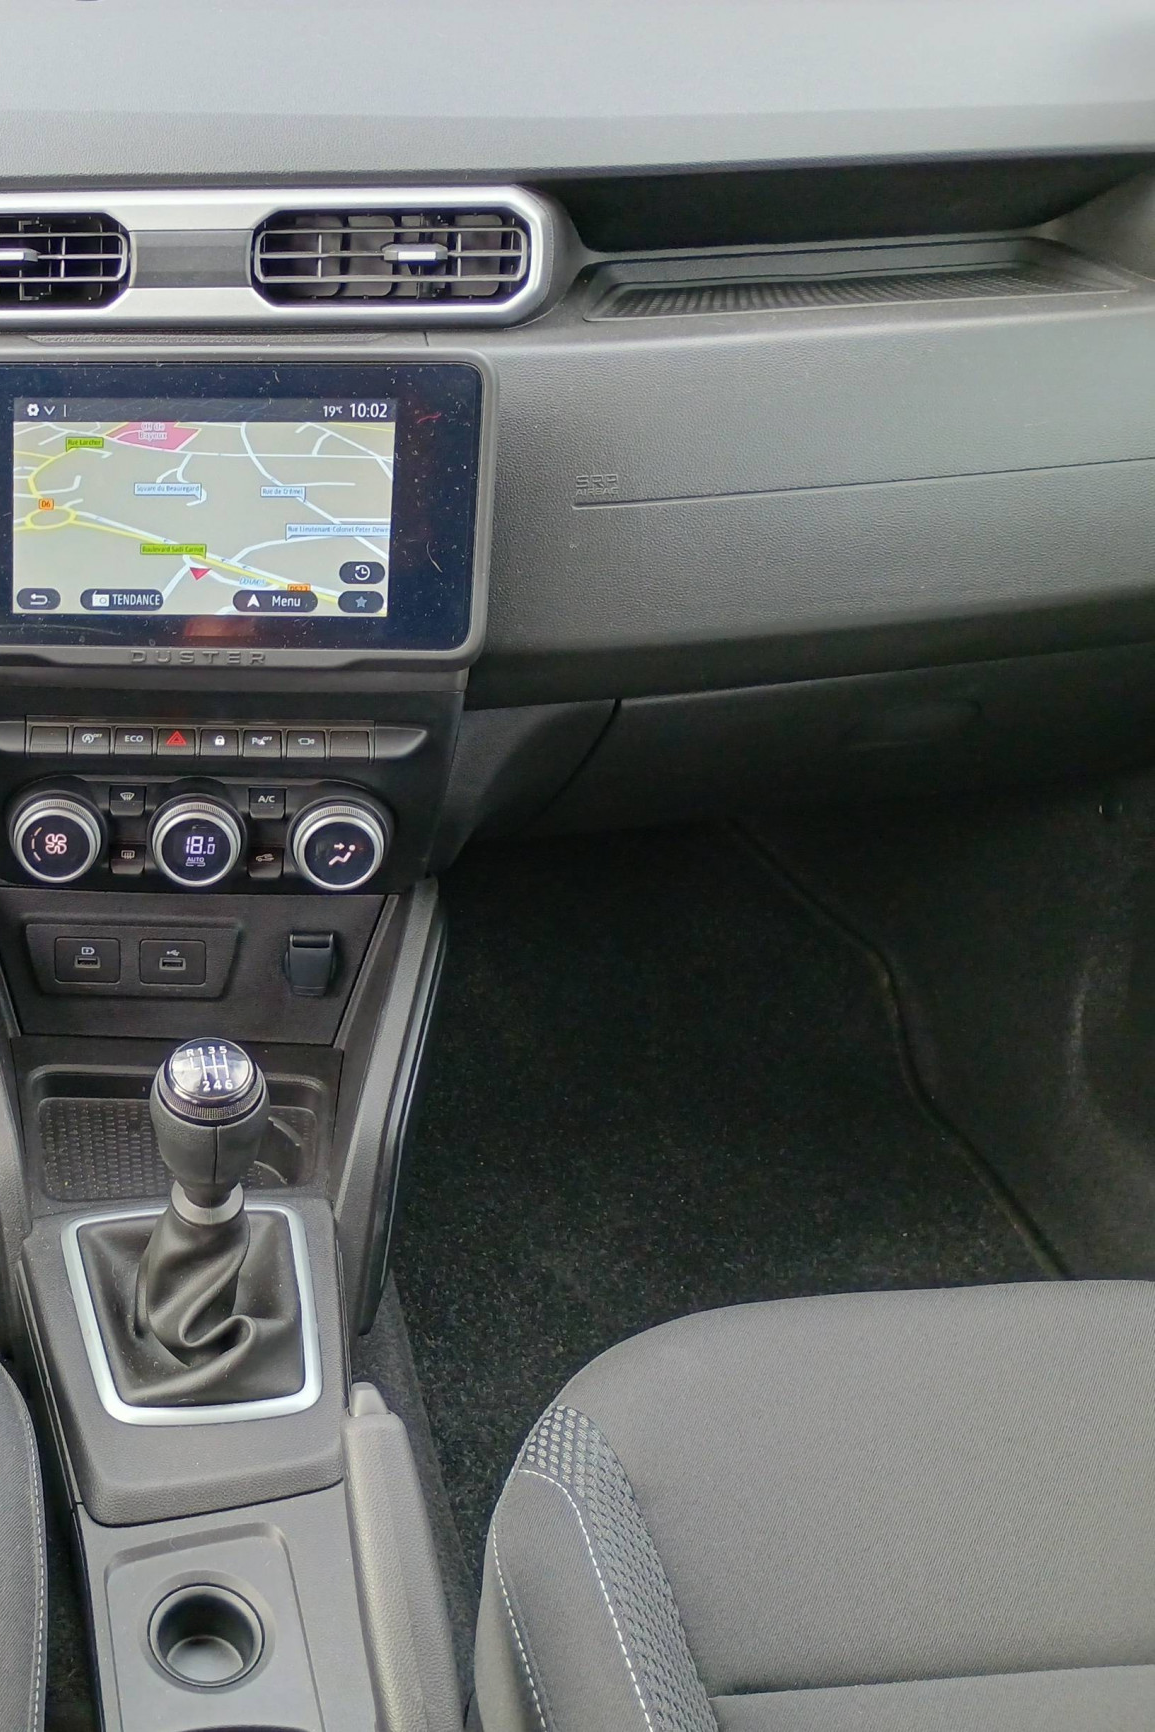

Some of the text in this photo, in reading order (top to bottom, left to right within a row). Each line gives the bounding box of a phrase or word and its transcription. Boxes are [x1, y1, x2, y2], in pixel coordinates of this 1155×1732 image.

[350, 403, 388, 418] 10:02
[112, 594, 160, 606] TENDANCE
[272, 596, 301, 607] Menu
[131, 650, 266, 664] DUSTER
[124, 735, 143, 743] ECO
[258, 795, 275, 803] A/C
[186, 1049, 194, 1057] R
[208, 1046, 215, 1054] 3
[219, 1046, 227, 1054] 5
[202, 1079, 233, 1092] 2 4 6
